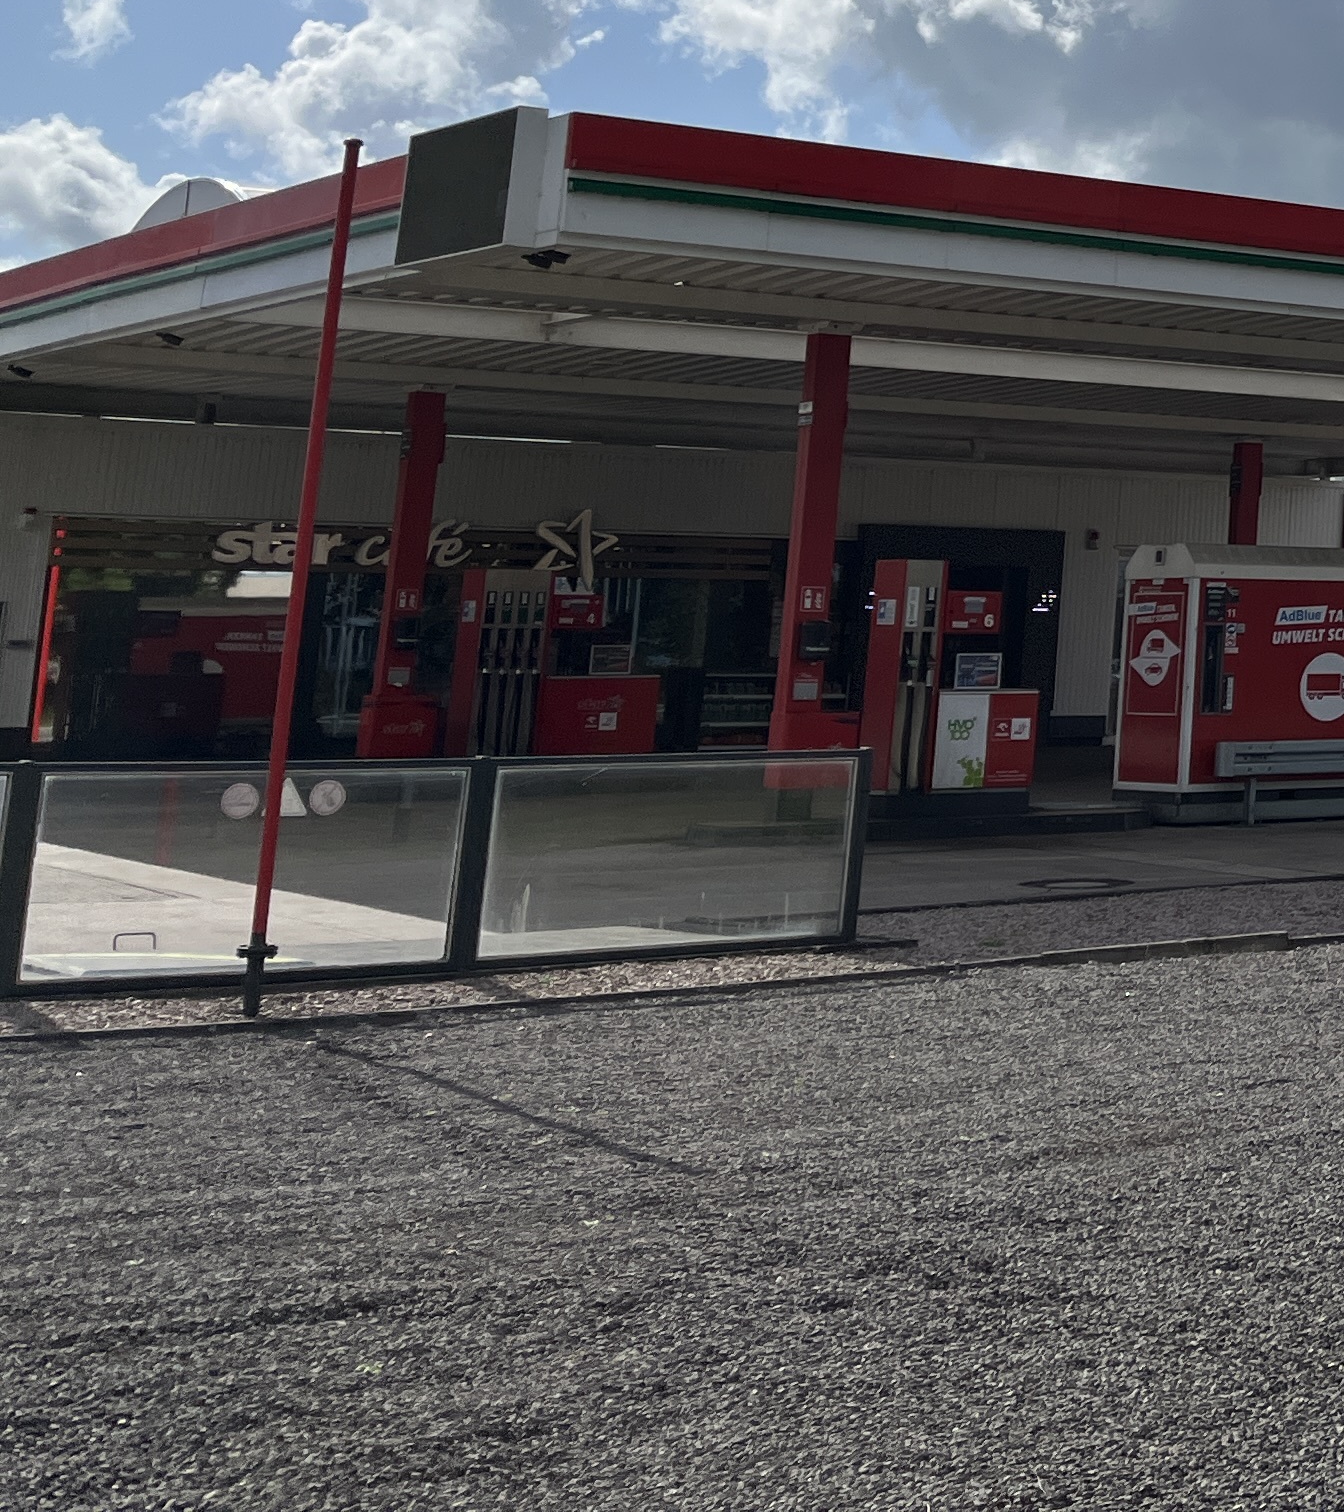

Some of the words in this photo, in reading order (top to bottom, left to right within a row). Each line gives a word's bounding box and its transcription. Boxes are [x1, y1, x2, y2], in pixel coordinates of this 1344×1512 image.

[212, 521, 345, 565] star
[354, 519, 473, 568] cfé
[586, 613, 596, 624] 4
[983, 612, 994, 628] 6
[1279, 609, 1322, 622] AdBlue
[1272, 628, 1325, 645] UMWELT
[948, 718, 975, 731] HVO
[950, 730, 970, 741] 100
